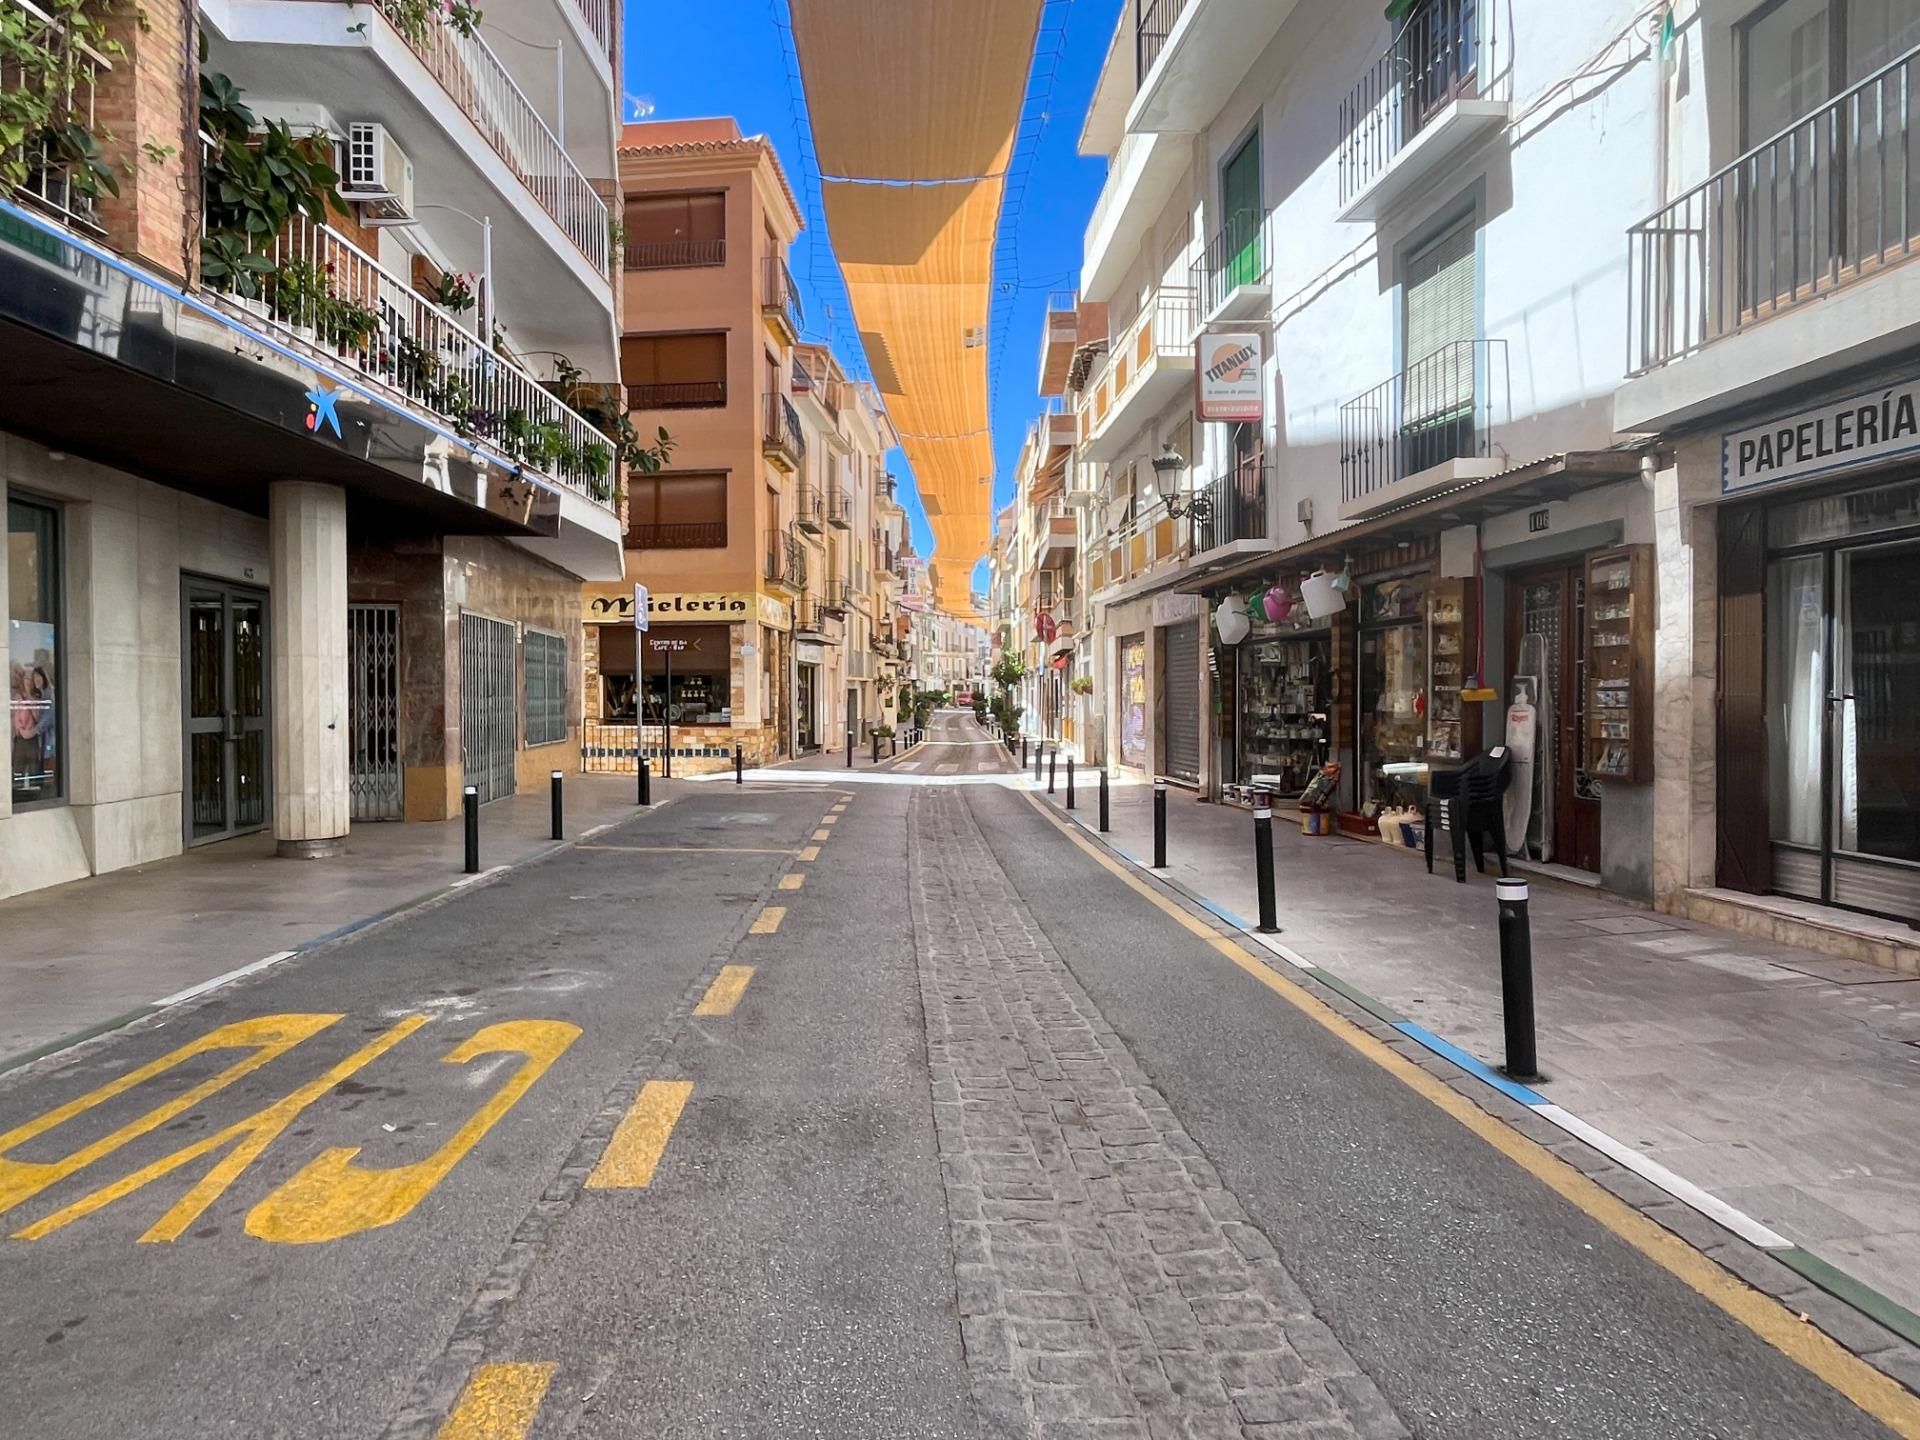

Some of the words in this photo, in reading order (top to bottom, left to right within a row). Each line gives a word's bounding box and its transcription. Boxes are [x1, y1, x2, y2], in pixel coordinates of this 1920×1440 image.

[1205, 343, 1257, 382] TITANLUX
[1738, 389, 1918, 477] PAPELERÍA
[1530, 511, 1549, 531] 106
[591, 596, 746, 618] Mielería
